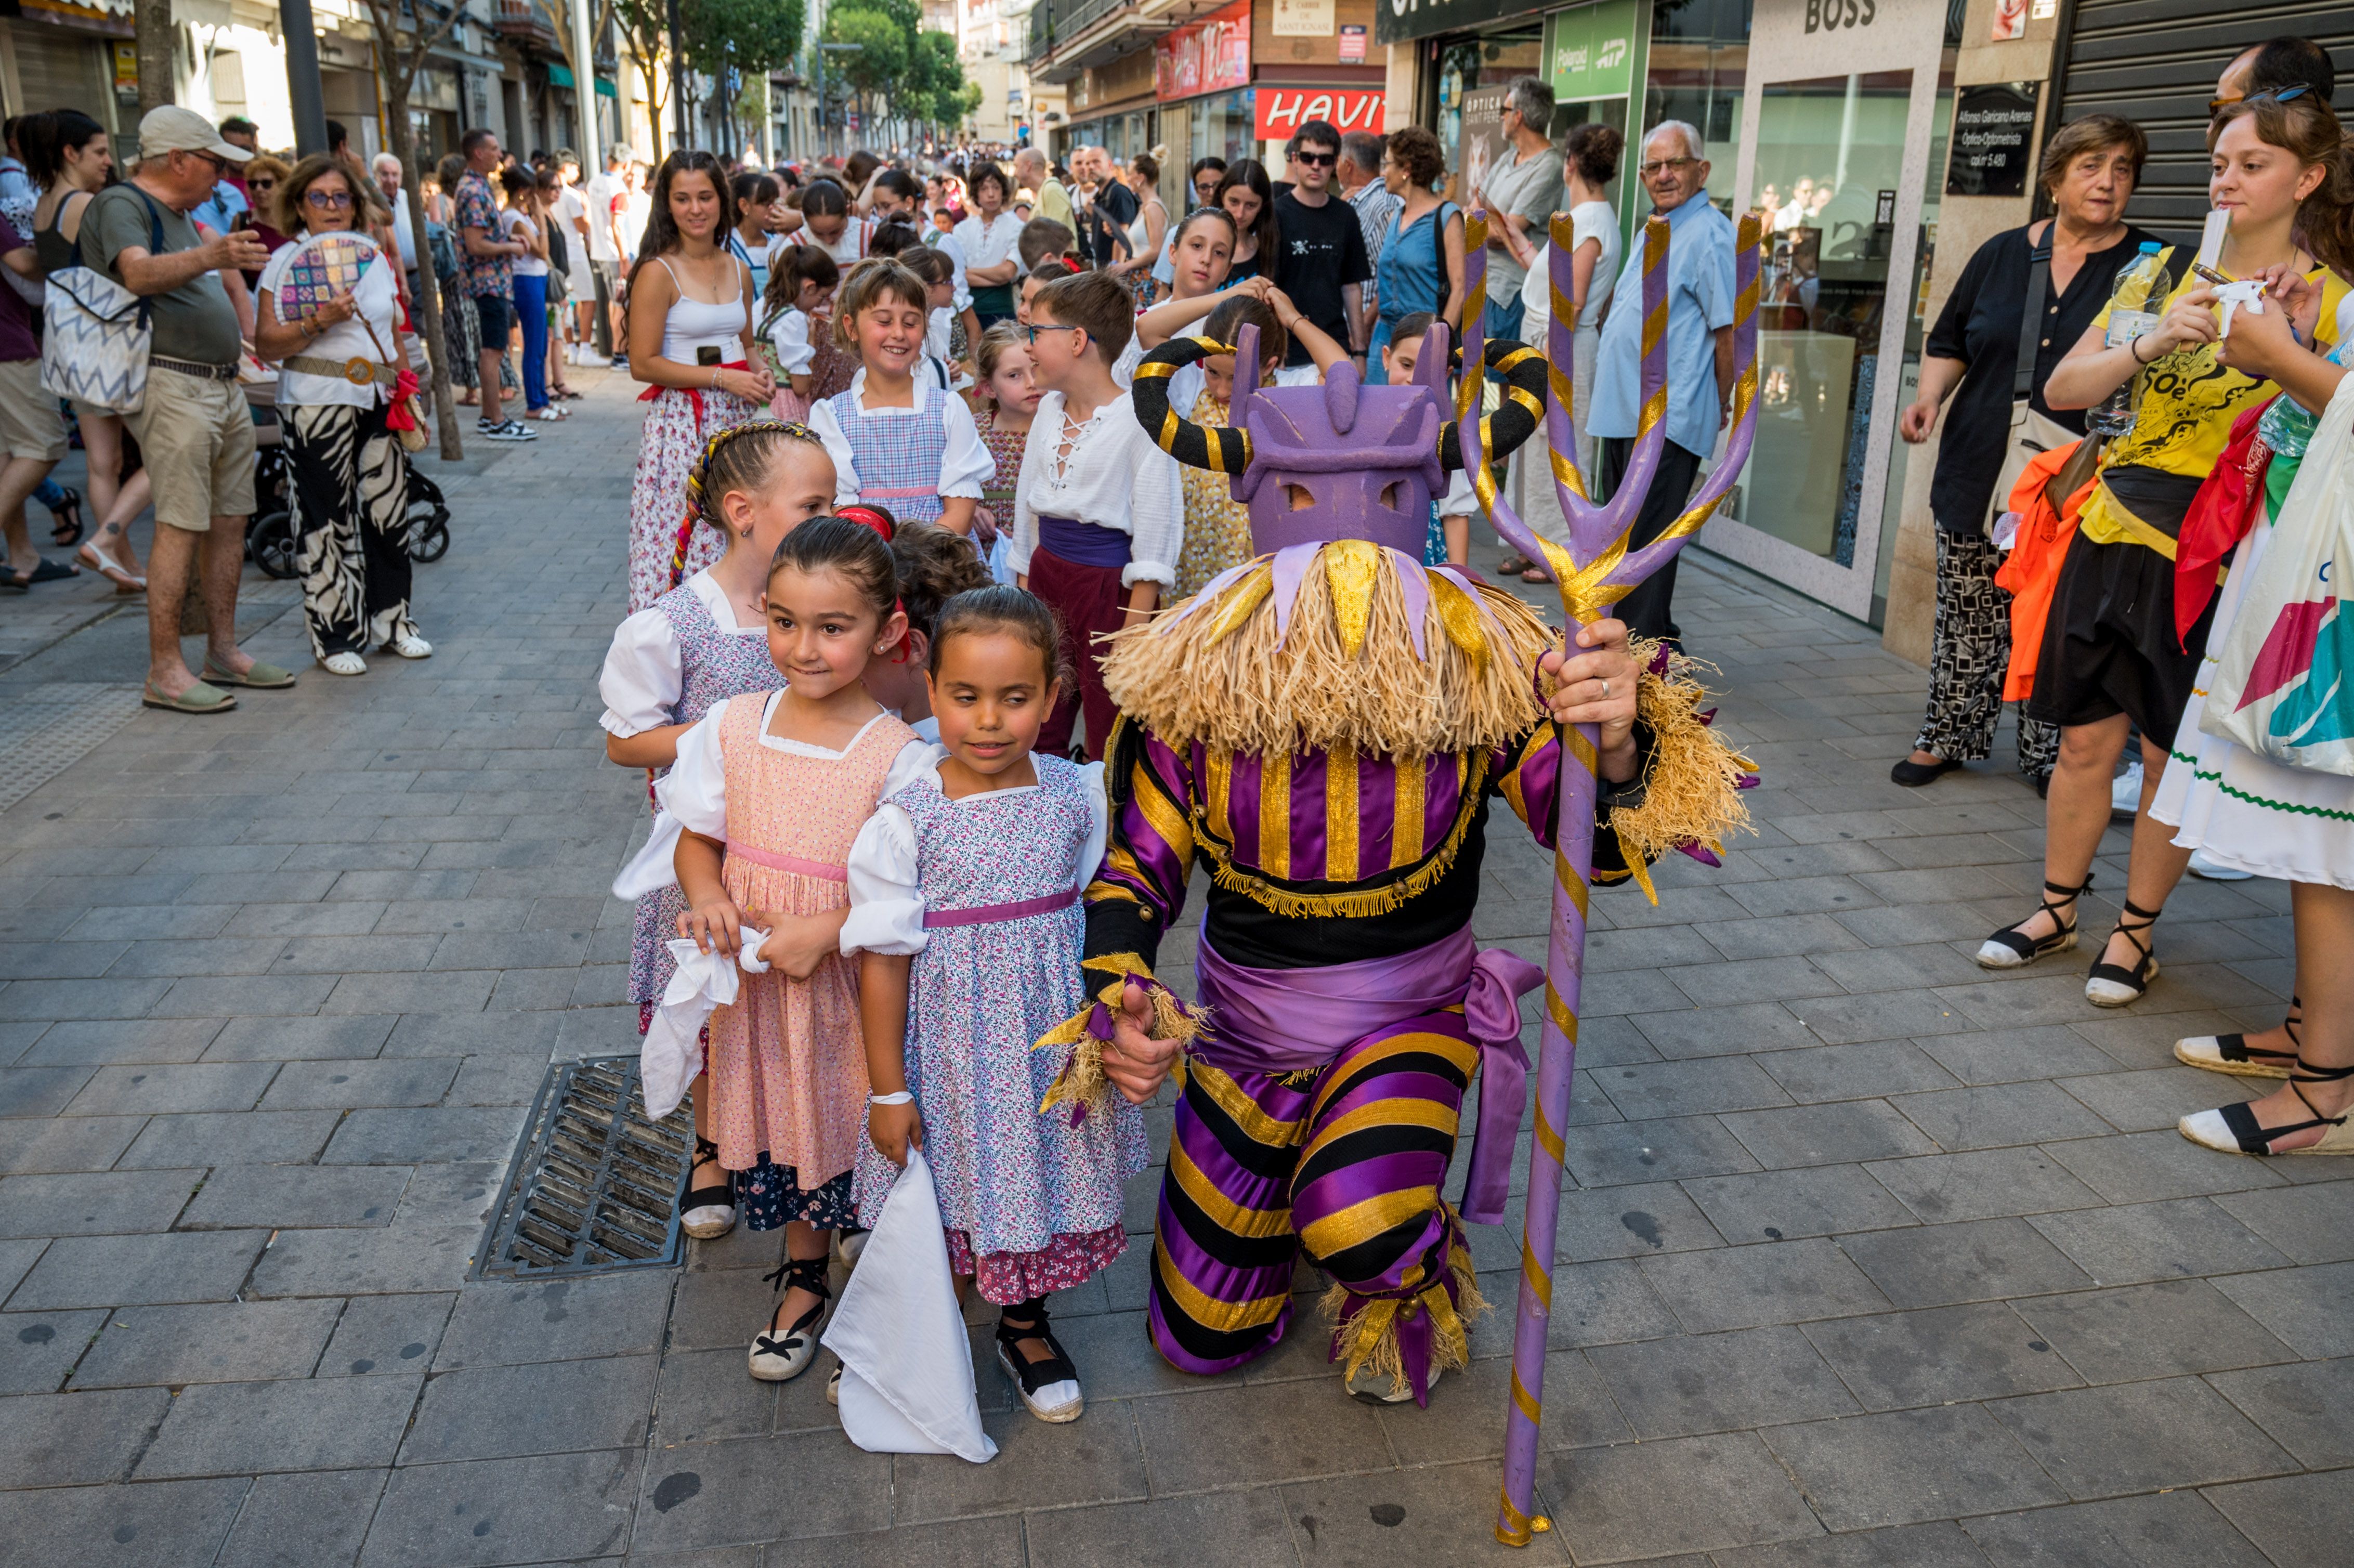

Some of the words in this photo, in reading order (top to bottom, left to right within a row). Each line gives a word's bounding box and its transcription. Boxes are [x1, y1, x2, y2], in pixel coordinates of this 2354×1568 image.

[1804, 0, 1876, 34] BOSS
[1595, 38, 1626, 69] ATP
[1266, 92, 1386, 128] HAVI
[1467, 97, 1501, 113] ÓPTICA
[1958, 110, 1981, 123] Alfonso
[1982, 109, 2009, 123] Garicano
[2010, 108, 2032, 122] Arenas
